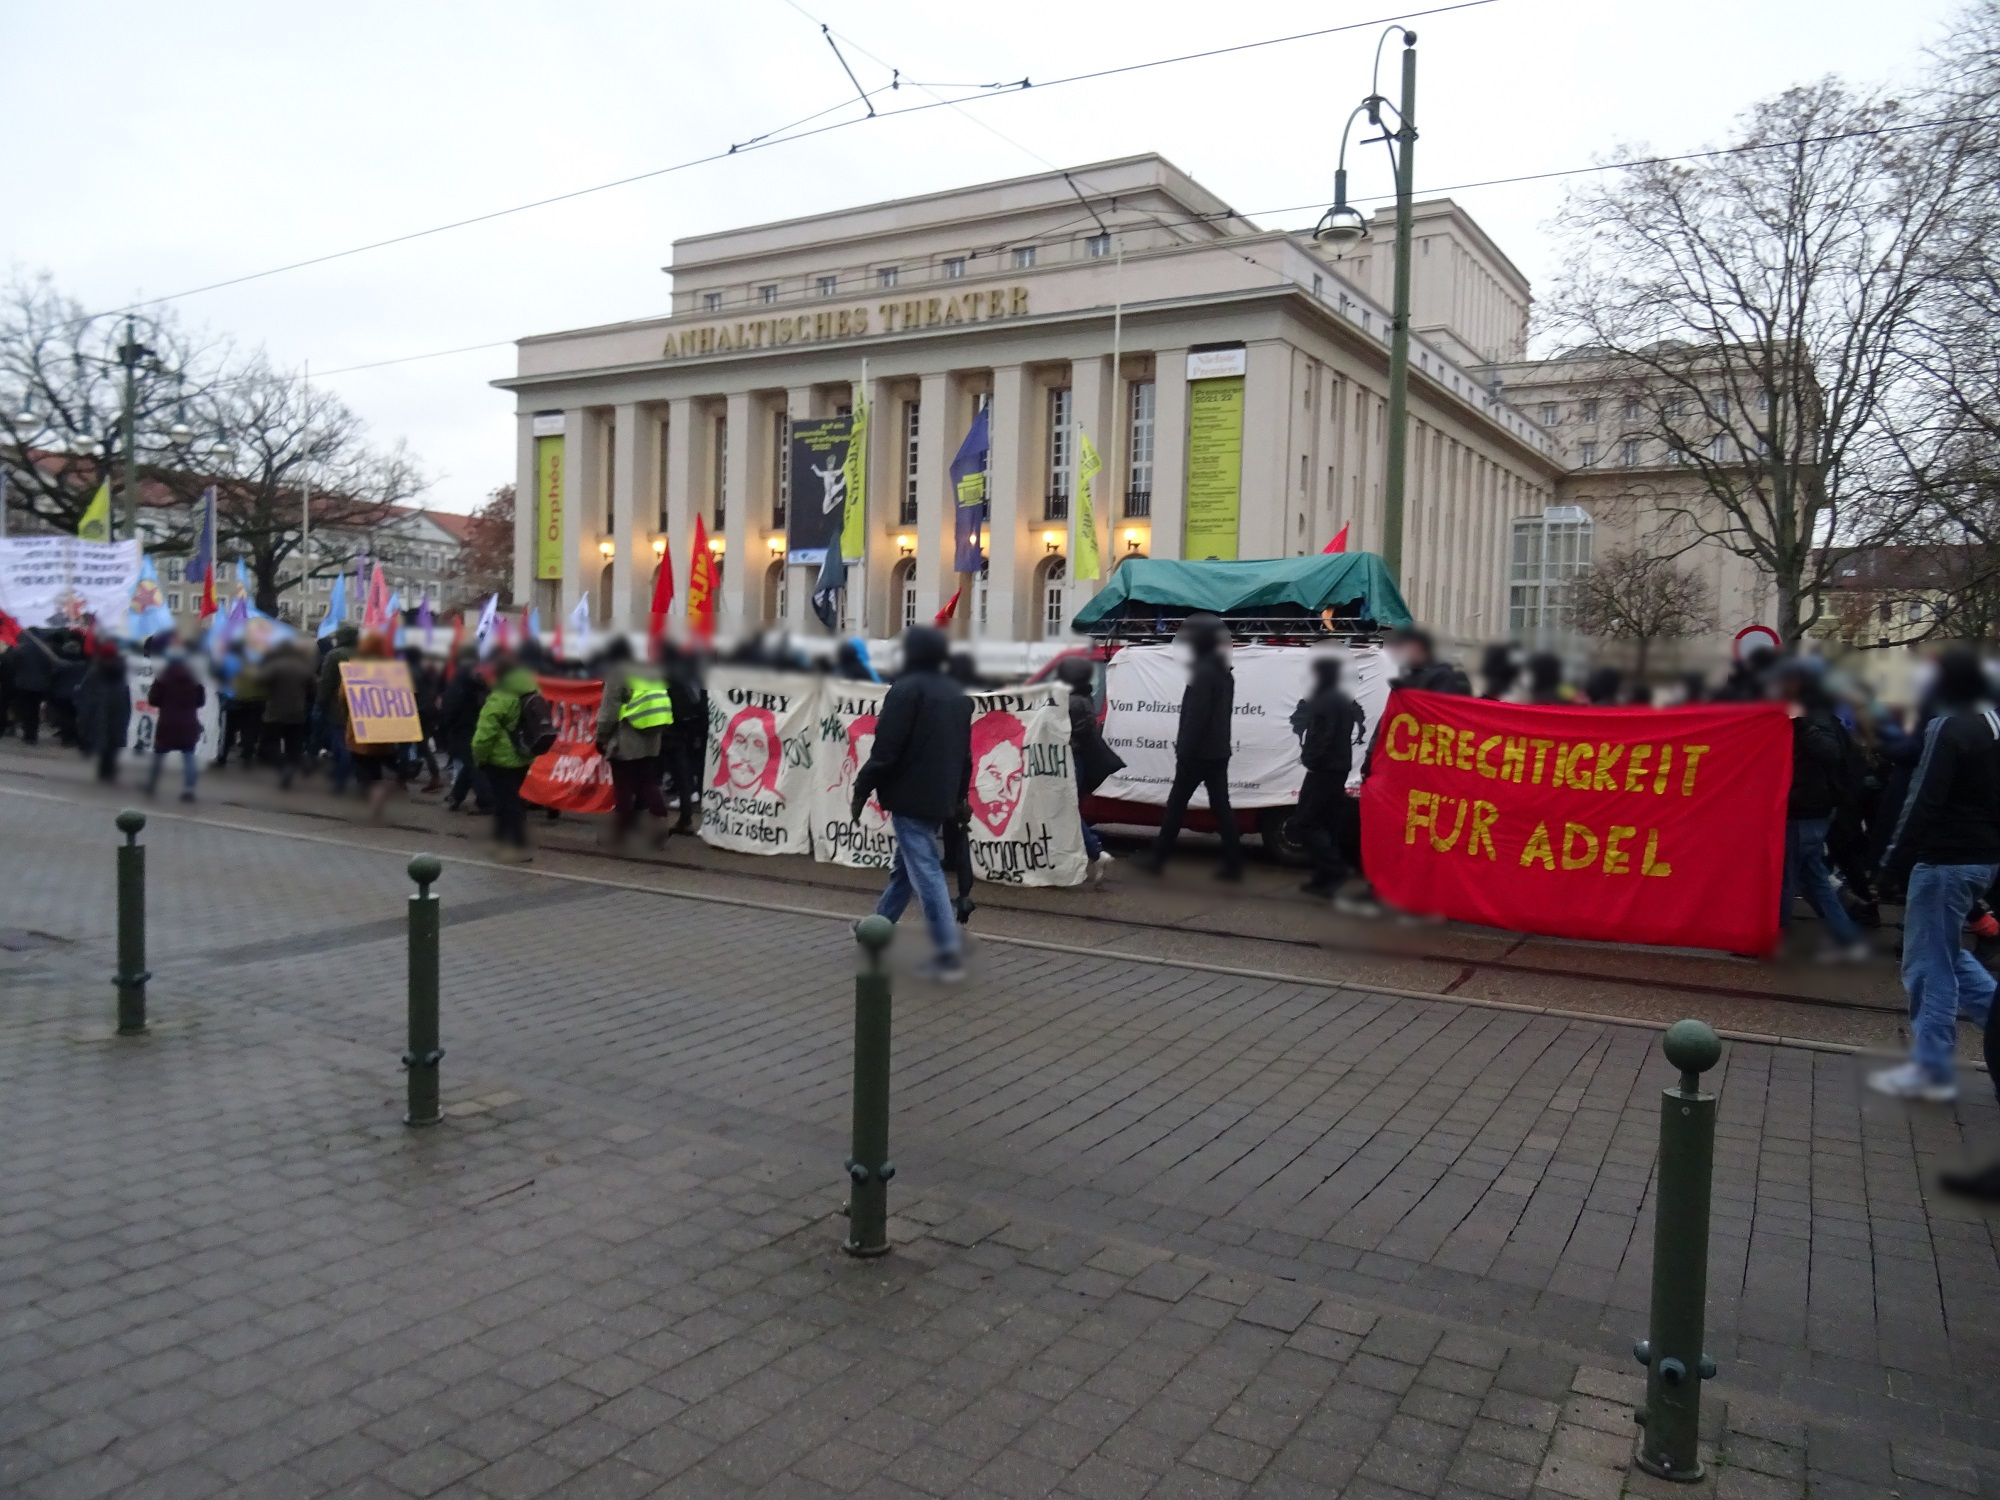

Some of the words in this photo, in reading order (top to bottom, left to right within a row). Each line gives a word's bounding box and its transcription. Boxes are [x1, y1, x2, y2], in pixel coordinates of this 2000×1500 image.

[663, 307, 869, 358] ANHALTISCHES
[879, 286, 1030, 332] THEATER
[348, 687, 415, 718] MORD
[728, 688, 791, 713] OURY
[1109, 699, 1133, 712] Von
[1137, 699, 1182, 714] Polizist
[1231, 702, 1266, 717] rdet,
[1107, 737, 1133, 748] vom
[1135, 736, 1168, 749] Staat
[1386, 713, 1710, 796] GERECHTIGKEIT
[968, 822, 1056, 870] ermordet
[1405, 789, 1500, 862] FÜR
[1519, 820, 1673, 877] ADEL
